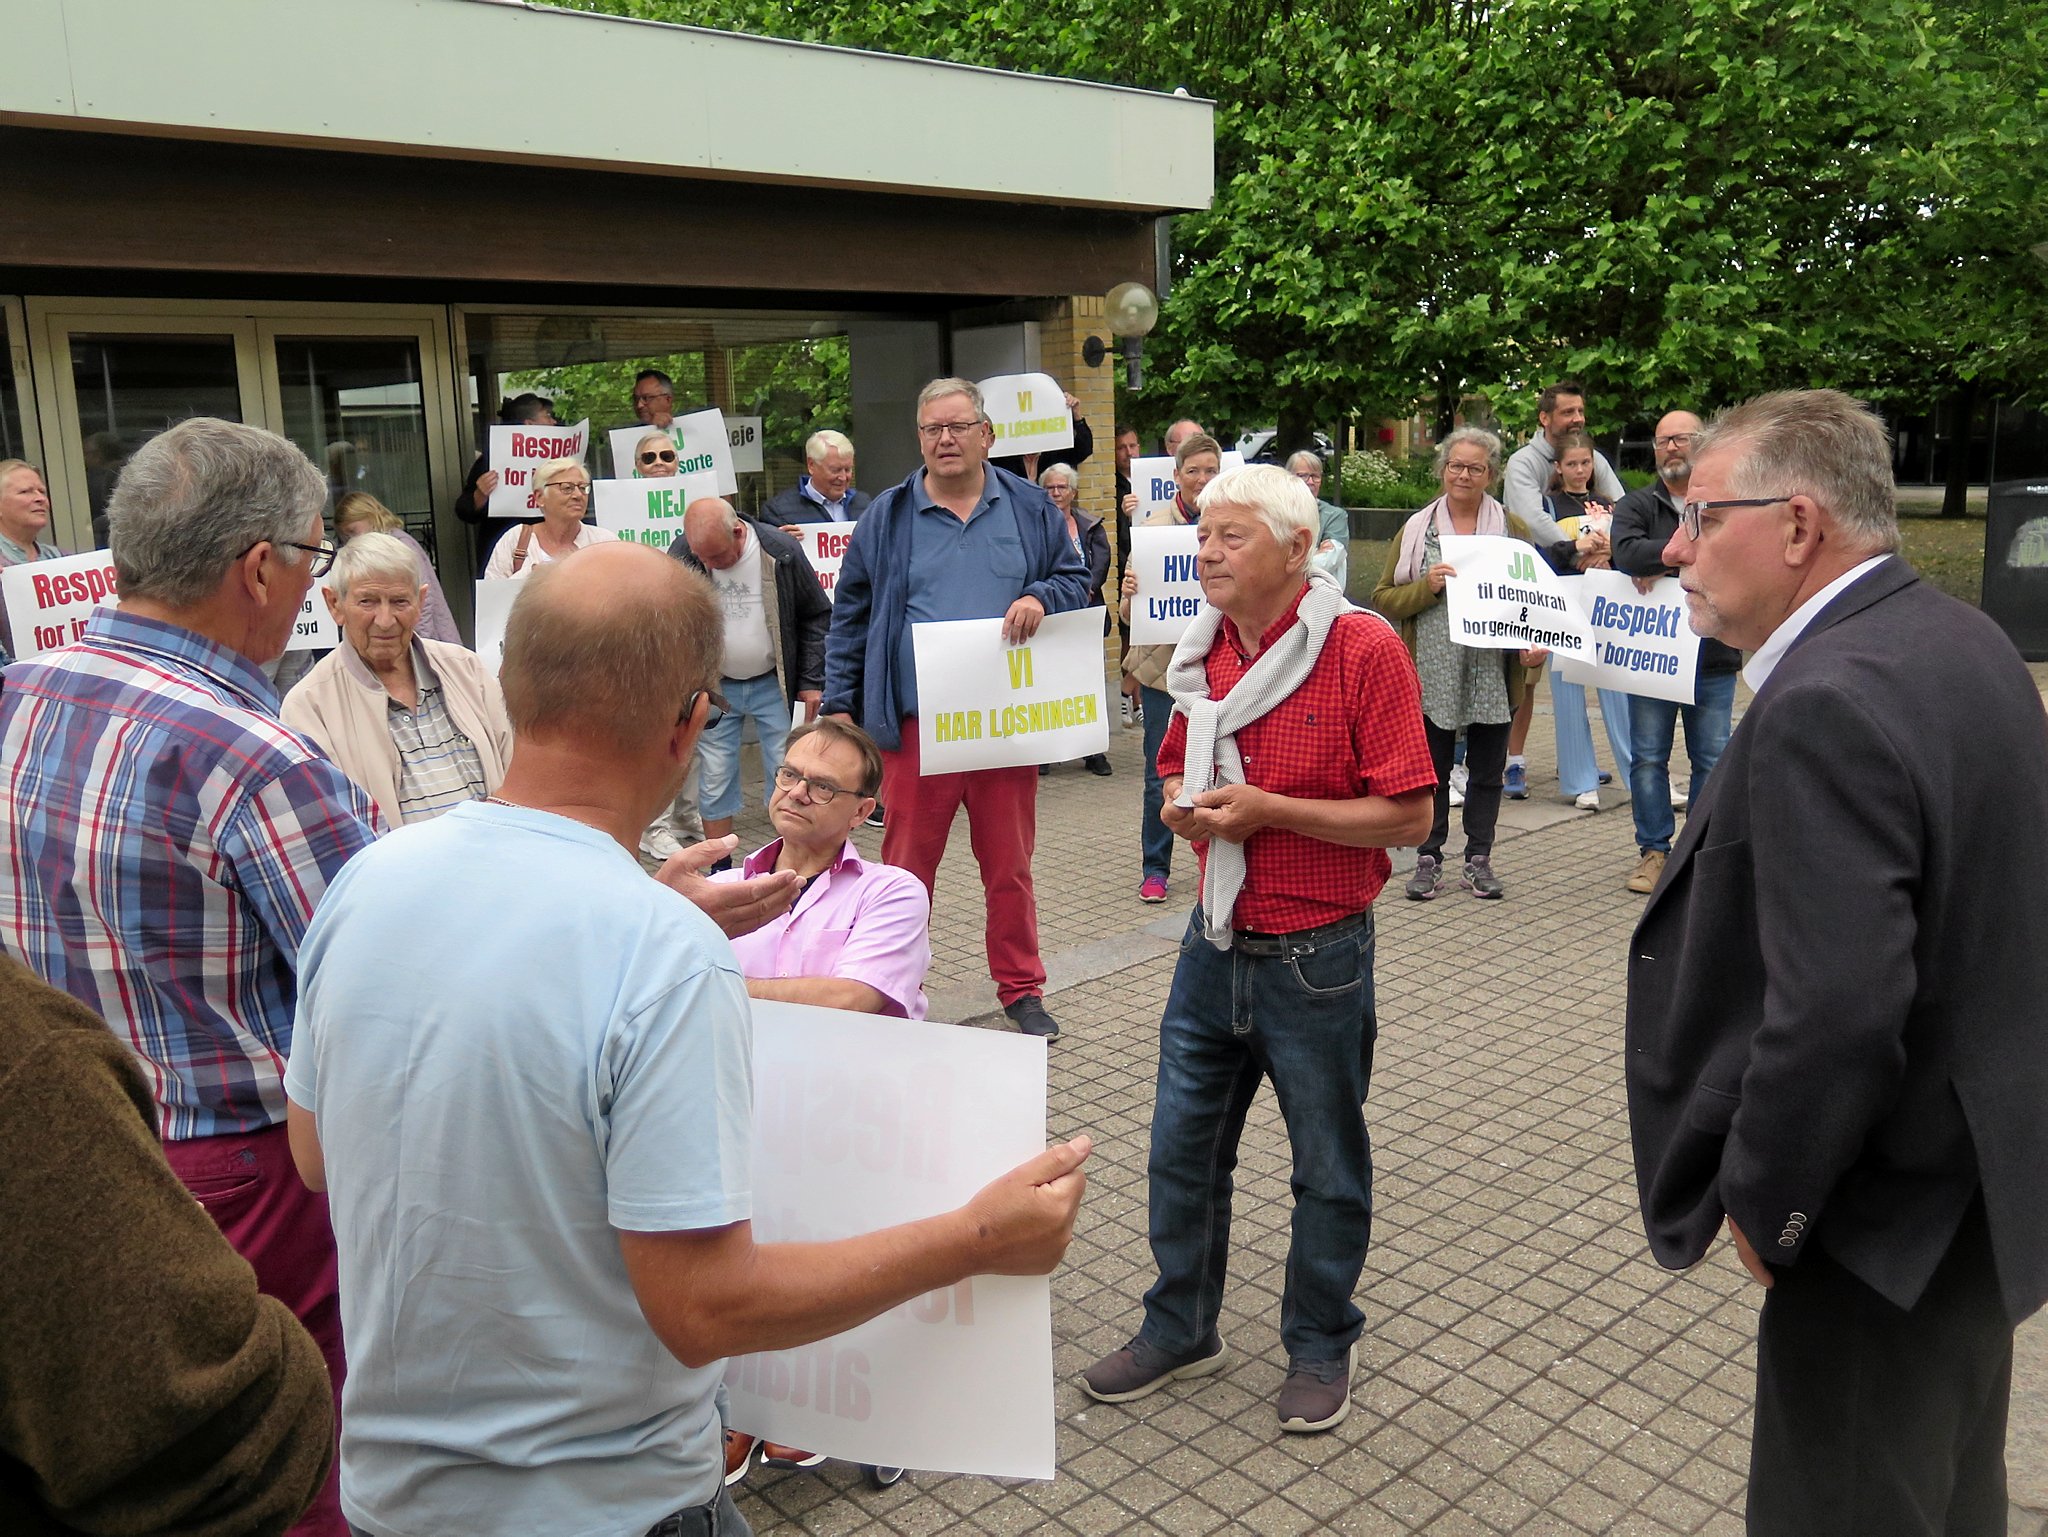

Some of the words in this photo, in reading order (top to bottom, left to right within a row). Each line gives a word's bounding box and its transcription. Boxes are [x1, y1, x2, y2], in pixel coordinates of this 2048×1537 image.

[1017, 391, 1032, 413] VI
[511, 431, 582, 459] Respekt
[726, 425, 754, 447] eje
[504, 468, 527, 486] for
[679, 454, 713, 474] sorte
[647, 489, 686, 519] NEJ
[641, 528, 671, 547] den
[817, 532, 852, 559] Res
[1507, 551, 1537, 583] JA
[32, 566, 118, 609] Respe
[1478, 582, 1493, 599] til
[1498, 584, 1567, 612] demokrati
[1149, 596, 1201, 621] Lytter
[1519, 606, 1528, 622] &
[1591, 595, 1681, 638] Respekt
[34, 624, 65, 651] for
[296, 620, 318, 636] syd
[1463, 617, 1582, 650] borgerindragelse
[1006, 647, 1033, 689] VI
[1604, 641, 1679, 676] borgerne
[936, 710, 982, 742] HAR
[989, 693, 1097, 738] LØSNINGEN
